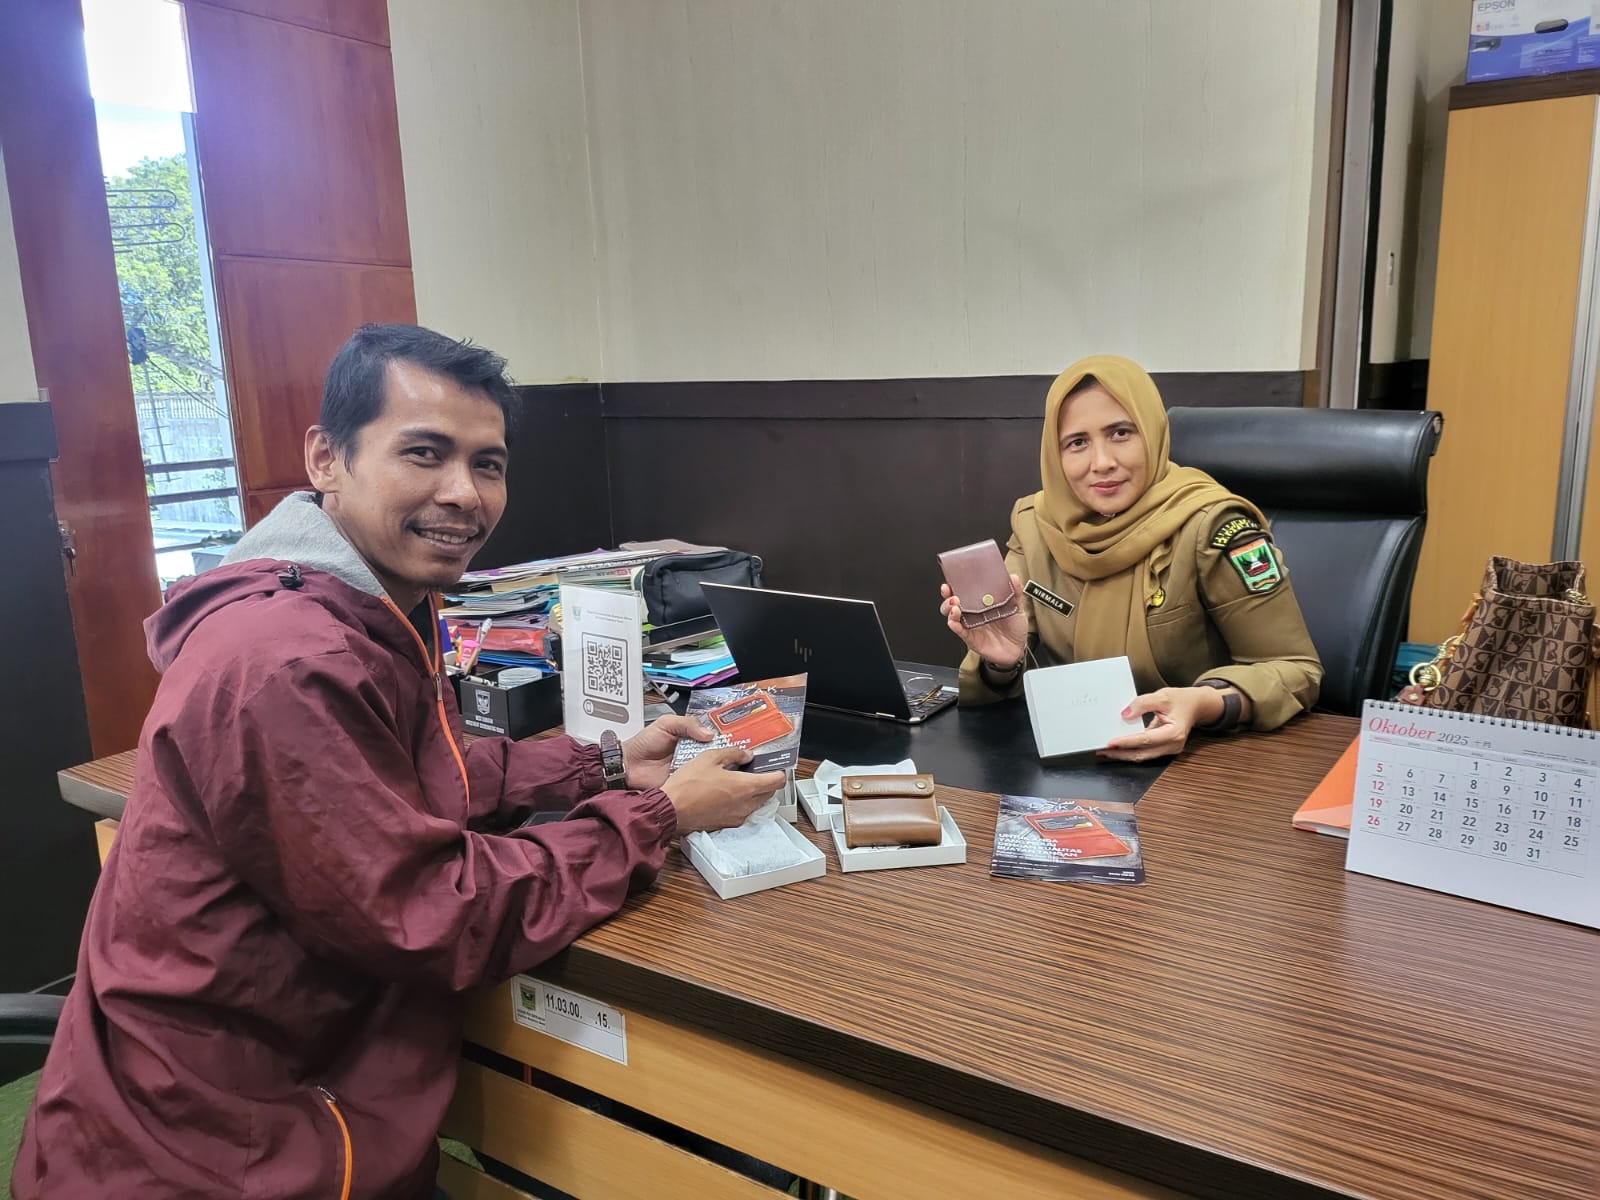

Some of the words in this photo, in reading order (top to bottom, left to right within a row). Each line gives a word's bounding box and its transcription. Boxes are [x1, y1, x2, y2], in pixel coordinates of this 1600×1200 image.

[1478, 0, 1515, 12] EPSON
[1033, 586, 1064, 611] NIRMALA
[1369, 717, 1436, 740] Oktober
[1437, 732, 1470, 746] 2025
[1376, 762, 1384, 773] 5
[1406, 768, 1414, 779] 6
[1439, 773, 1446, 784] 7
[1470, 779, 1478, 790] 8
[1503, 785, 1511, 795] 9
[1534, 790, 1548, 802] 10
[1569, 796, 1583, 809] 11
[1473, 761, 1479, 771] 1
[1504, 766, 1513, 777] 2
[1539, 772, 1547, 783] 3
[1573, 778, 1582, 788] 4
[1372, 780, 1385, 792] 12
[1402, 785, 1415, 797] 13
[1433, 791, 1446, 802] 14
[1465, 797, 1479, 809] 15
[1498, 803, 1512, 815] 16
[1532, 809, 1546, 821] 17
[1567, 816, 1582, 828] 18
[1367, 814, 1380, 826] 26
[1397, 821, 1411, 832] 27
[1428, 827, 1442, 839] 28
[1460, 833, 1475, 845] 29
[1492, 840, 1508, 852] 30
[1526, 847, 1541, 859] 31
[1369, 797, 1383, 808] 19
[1399, 803, 1413, 815] 20
[1430, 809, 1443, 821] 21
[1462, 815, 1477, 827] 22
[1494, 821, 1510, 834] 23
[1528, 828, 1544, 841] 24
[1563, 834, 1579, 847] 25
[545, 993, 583, 1019] 11.03.00.
